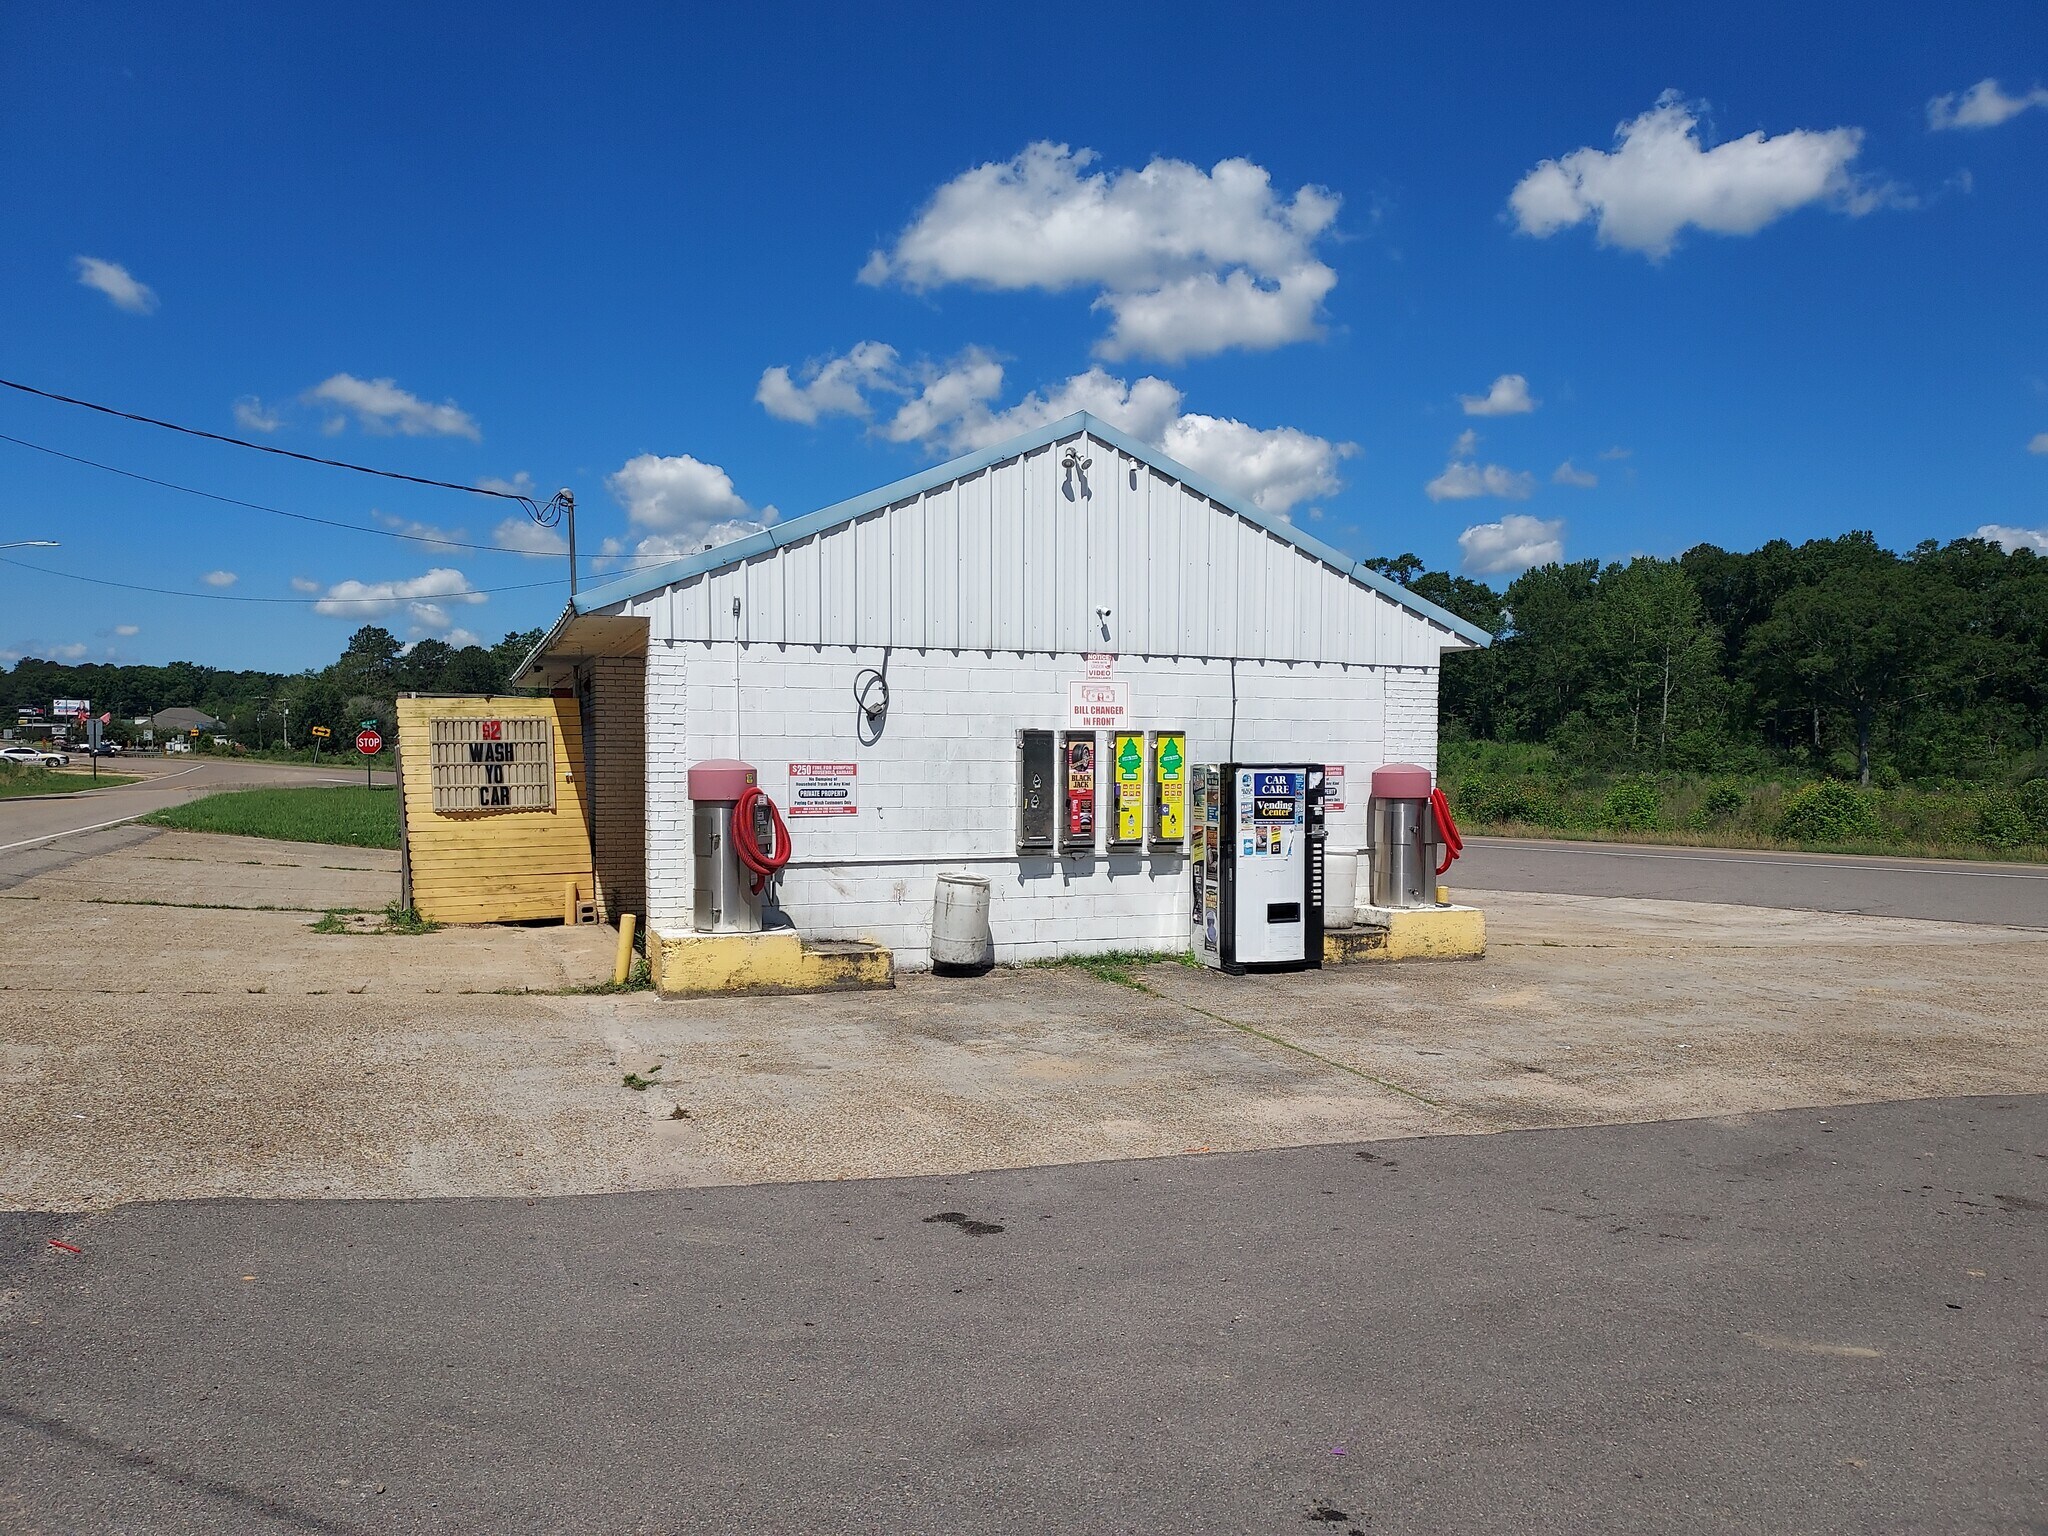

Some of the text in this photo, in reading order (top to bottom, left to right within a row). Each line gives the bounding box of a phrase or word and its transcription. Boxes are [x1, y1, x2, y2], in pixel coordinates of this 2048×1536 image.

[1074, 706, 1124, 714] BILL CHANGER
[1084, 718, 1116, 726] IN FRONT
[482, 720, 501, 740] $2
[358, 738, 380, 747] STOP
[469, 742, 514, 762] WASH
[486, 764, 503, 784] YO
[792, 764, 811, 775] $250
[1265, 776, 1287, 784] CAR
[1262, 785, 1290, 794] CARE
[480, 786, 510, 806] CAR
[1257, 800, 1293, 811] Vending
